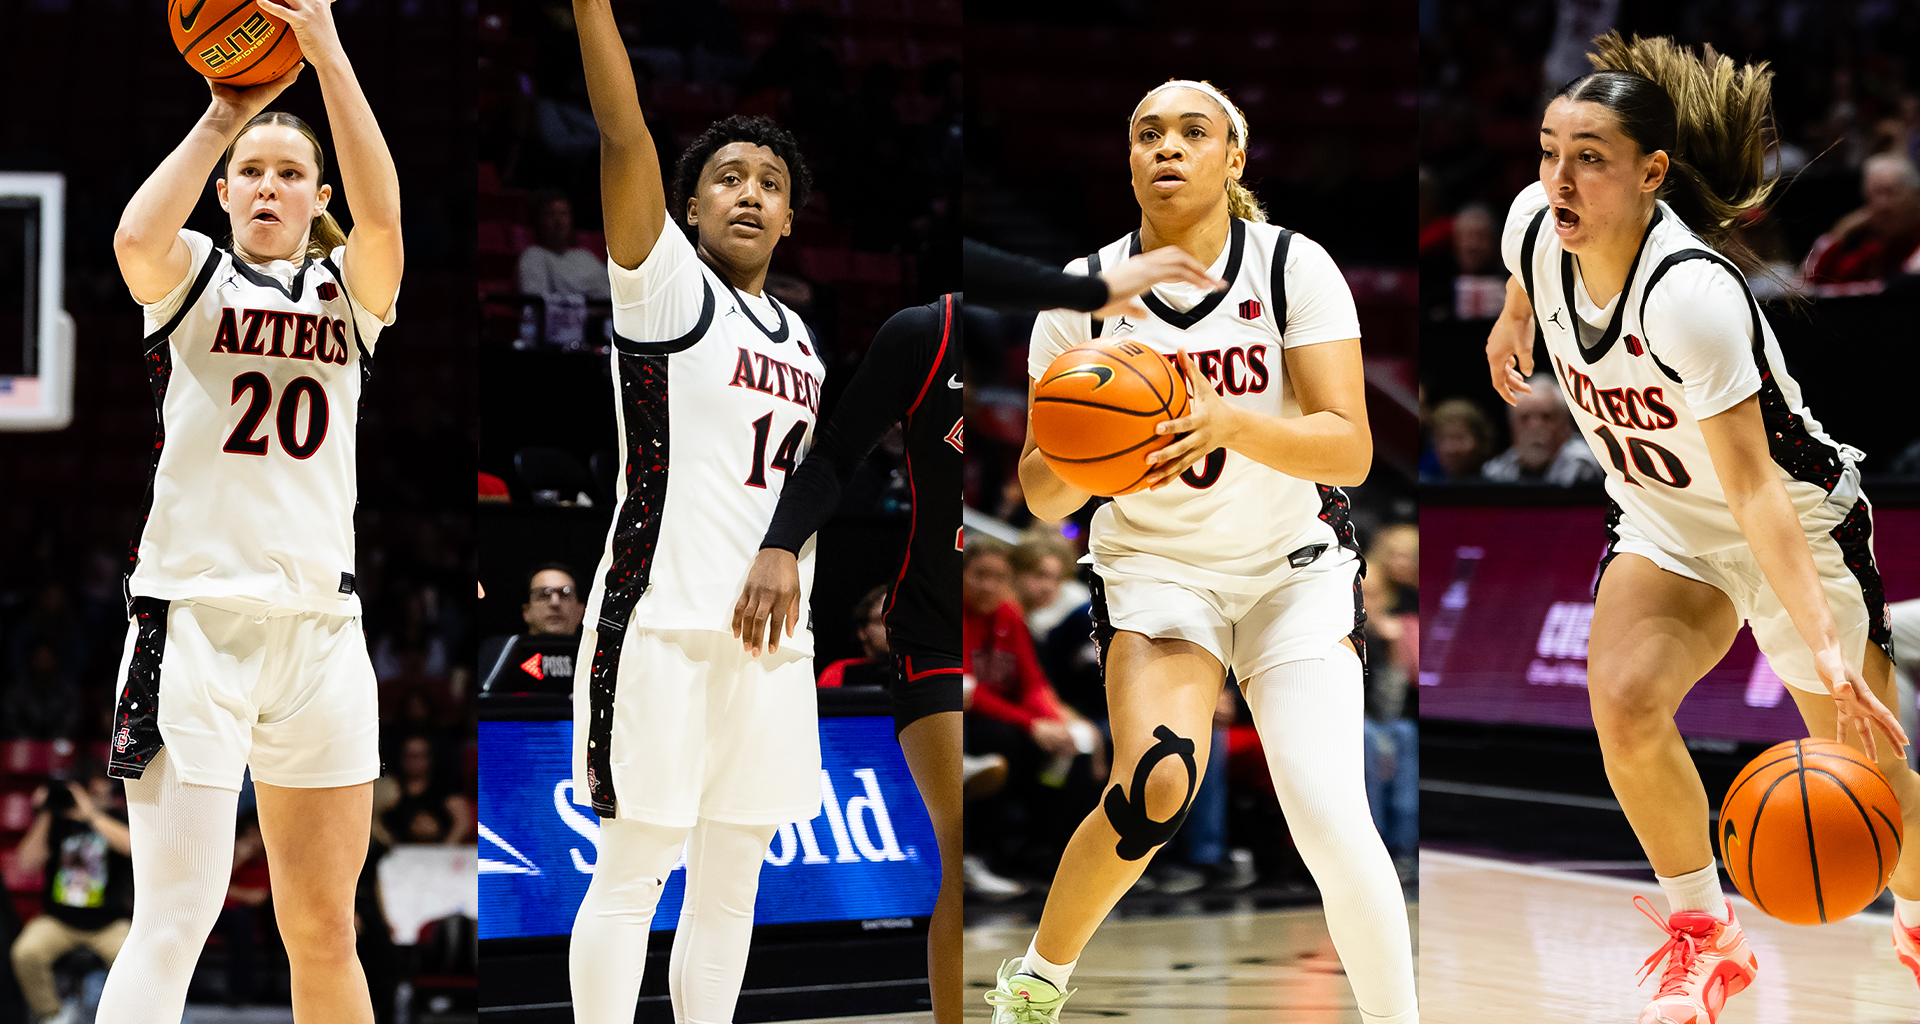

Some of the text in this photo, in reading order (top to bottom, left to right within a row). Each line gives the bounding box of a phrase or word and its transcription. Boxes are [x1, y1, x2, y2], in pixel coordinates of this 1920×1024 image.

[199, 10, 273, 70] ELITE
[215, 26, 276, 73] CHAMPIONSHIP
[209, 307, 349, 366] AZTECS
[1162, 344, 1270, 400] TECS
[222, 370, 330, 460] 20
[744, 409, 809, 498] 14
[1593, 423, 1692, 491] 10
